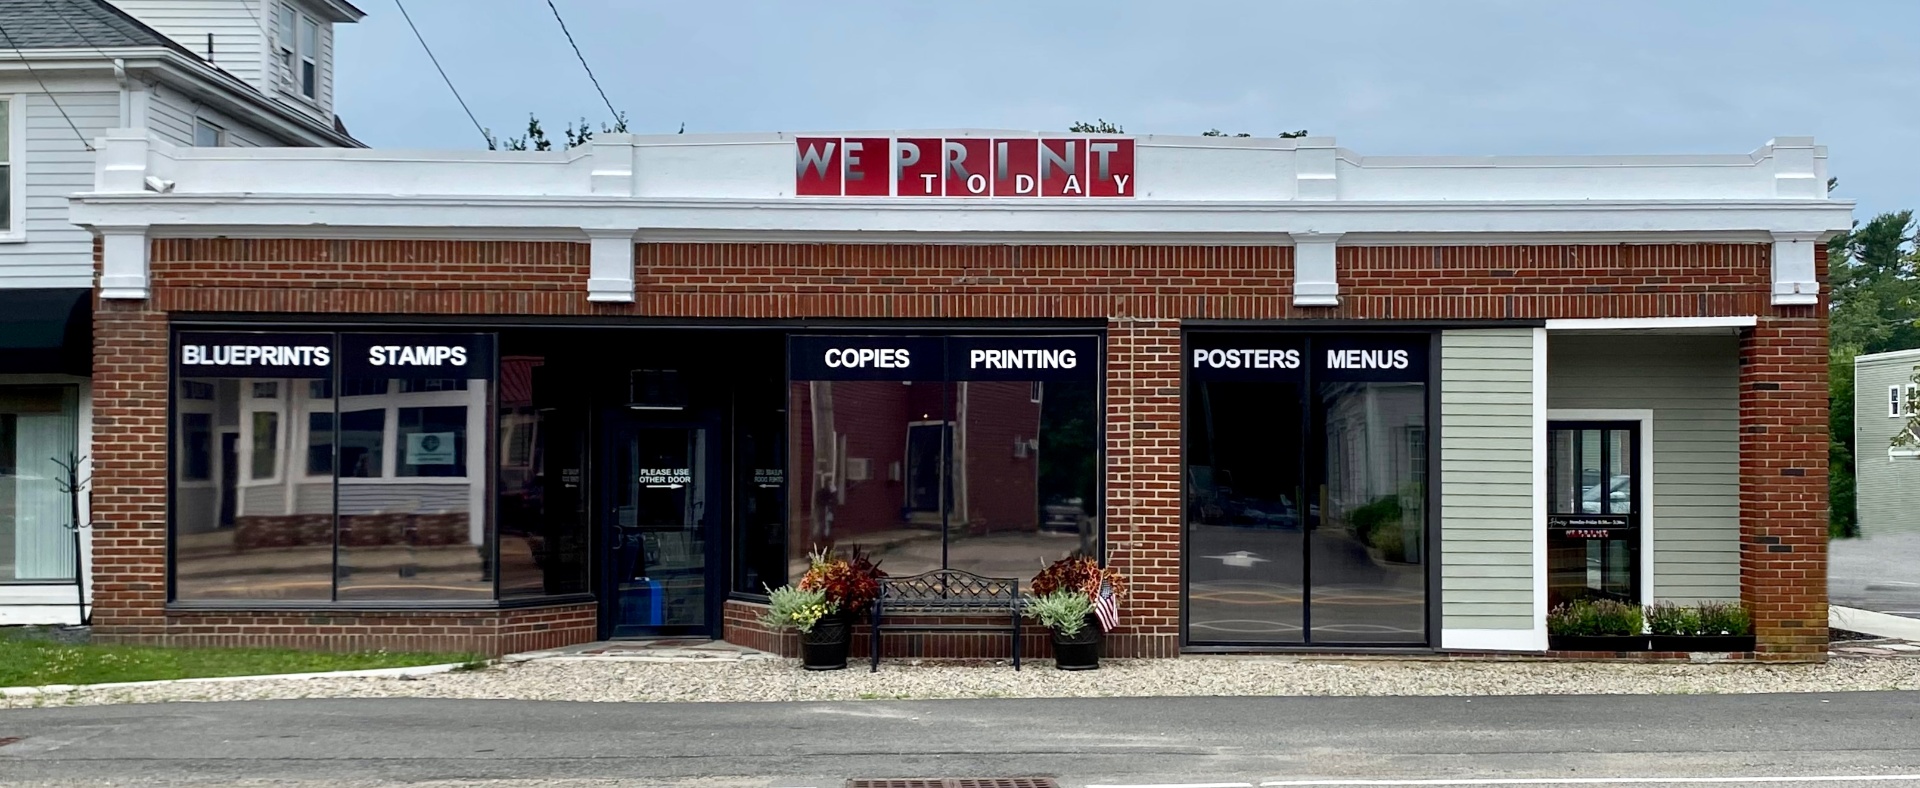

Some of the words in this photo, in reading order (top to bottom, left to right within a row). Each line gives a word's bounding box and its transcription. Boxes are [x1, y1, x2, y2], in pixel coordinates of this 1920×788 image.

[796, 142, 865, 181] WE
[897, 142, 1118, 181] PRINT
[920, 173, 1130, 195] TODAY
[182, 345, 330, 366] BLUEPRINTS
[369, 345, 467, 366] STAMPS
[824, 348, 910, 369] COPIES
[970, 349, 1077, 369] PRINTING
[1193, 348, 1300, 369] POSTERS
[1327, 349, 1409, 369] MENUS
[639, 475, 666, 484] OTHER
[667, 475, 691, 484] DOOR
[640, 468, 672, 476] PLEASE
[673, 468, 690, 476] USE
